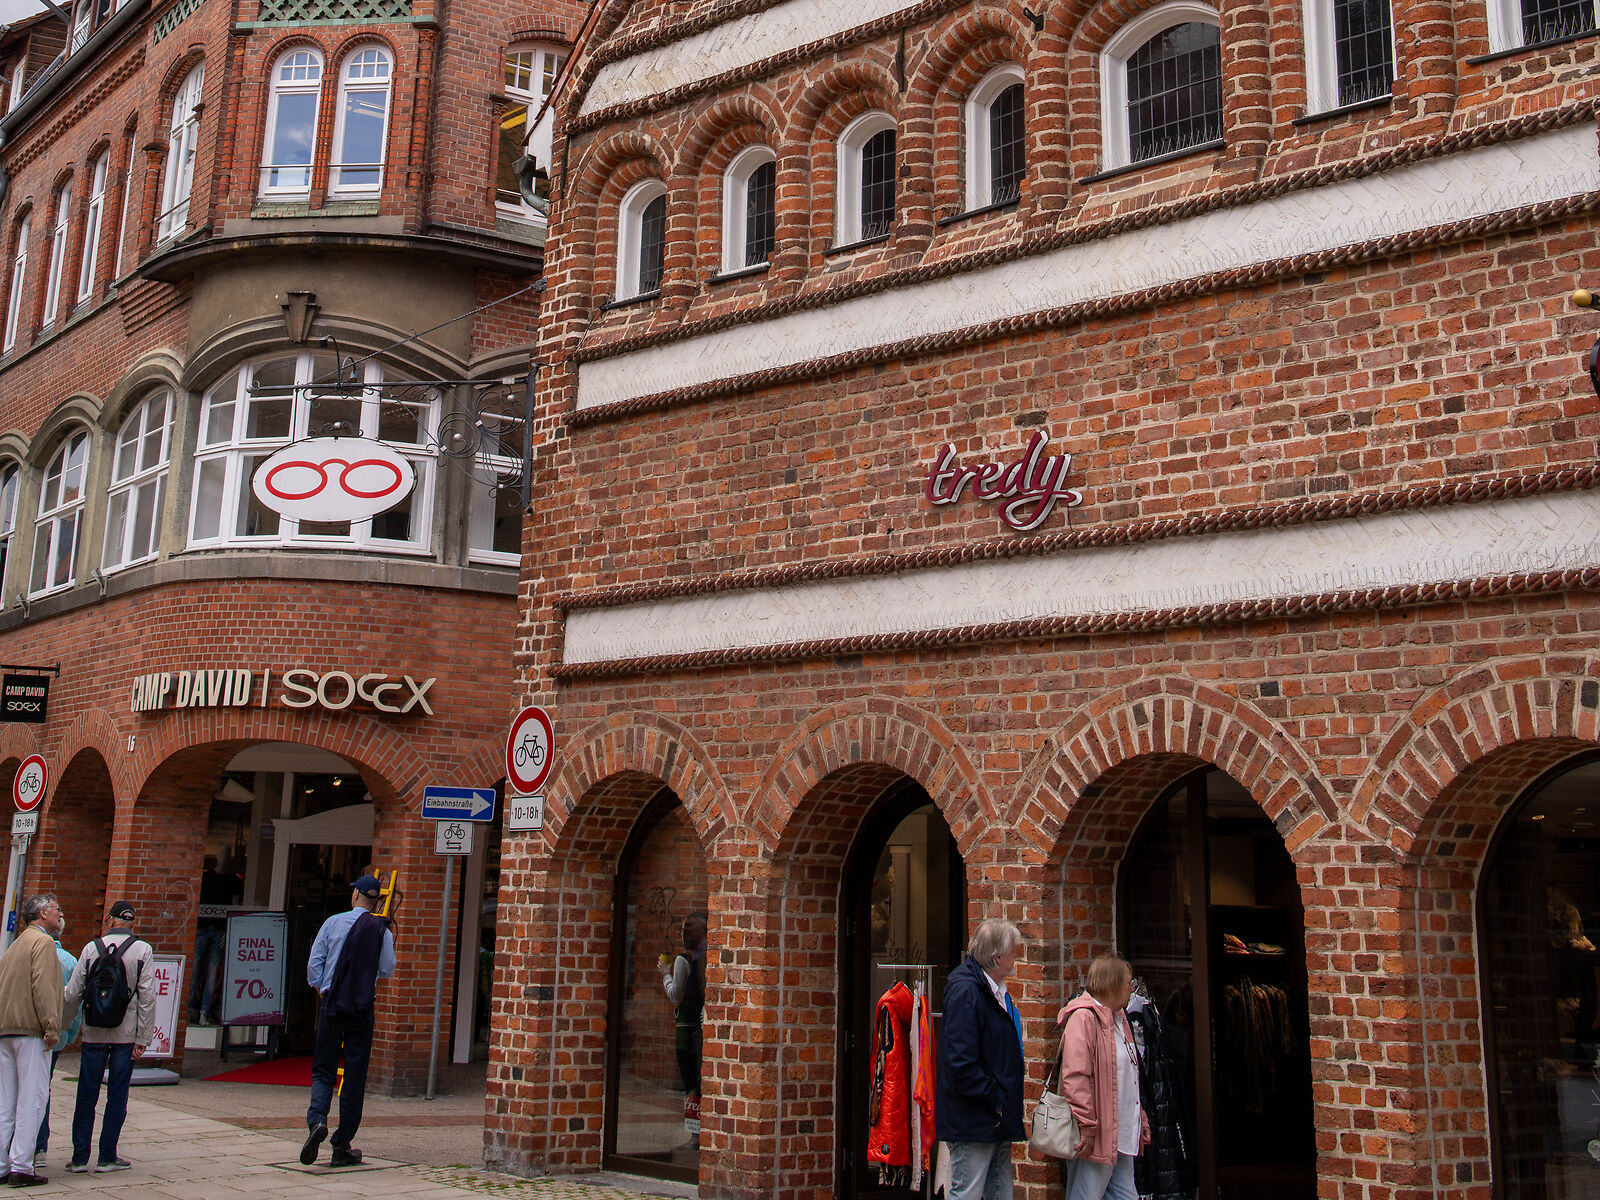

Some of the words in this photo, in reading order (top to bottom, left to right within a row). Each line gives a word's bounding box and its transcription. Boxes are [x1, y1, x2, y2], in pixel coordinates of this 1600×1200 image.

[924, 431, 1082, 530] tredy
[5, 685, 25, 696] CAMP
[25, 686, 45, 698] DAVID
[130, 672, 171, 713] CAMP
[175, 669, 252, 708] DAVID
[127, 735, 136, 752] 16
[426, 798, 474, 809] Einbahnstraße
[514, 806, 539, 820] 10-18h
[15, 818, 34, 828] 10-18h
[238, 938, 275, 949] FINAL
[237, 949, 275, 962] SALE
[234, 978, 274, 1000] 70%
